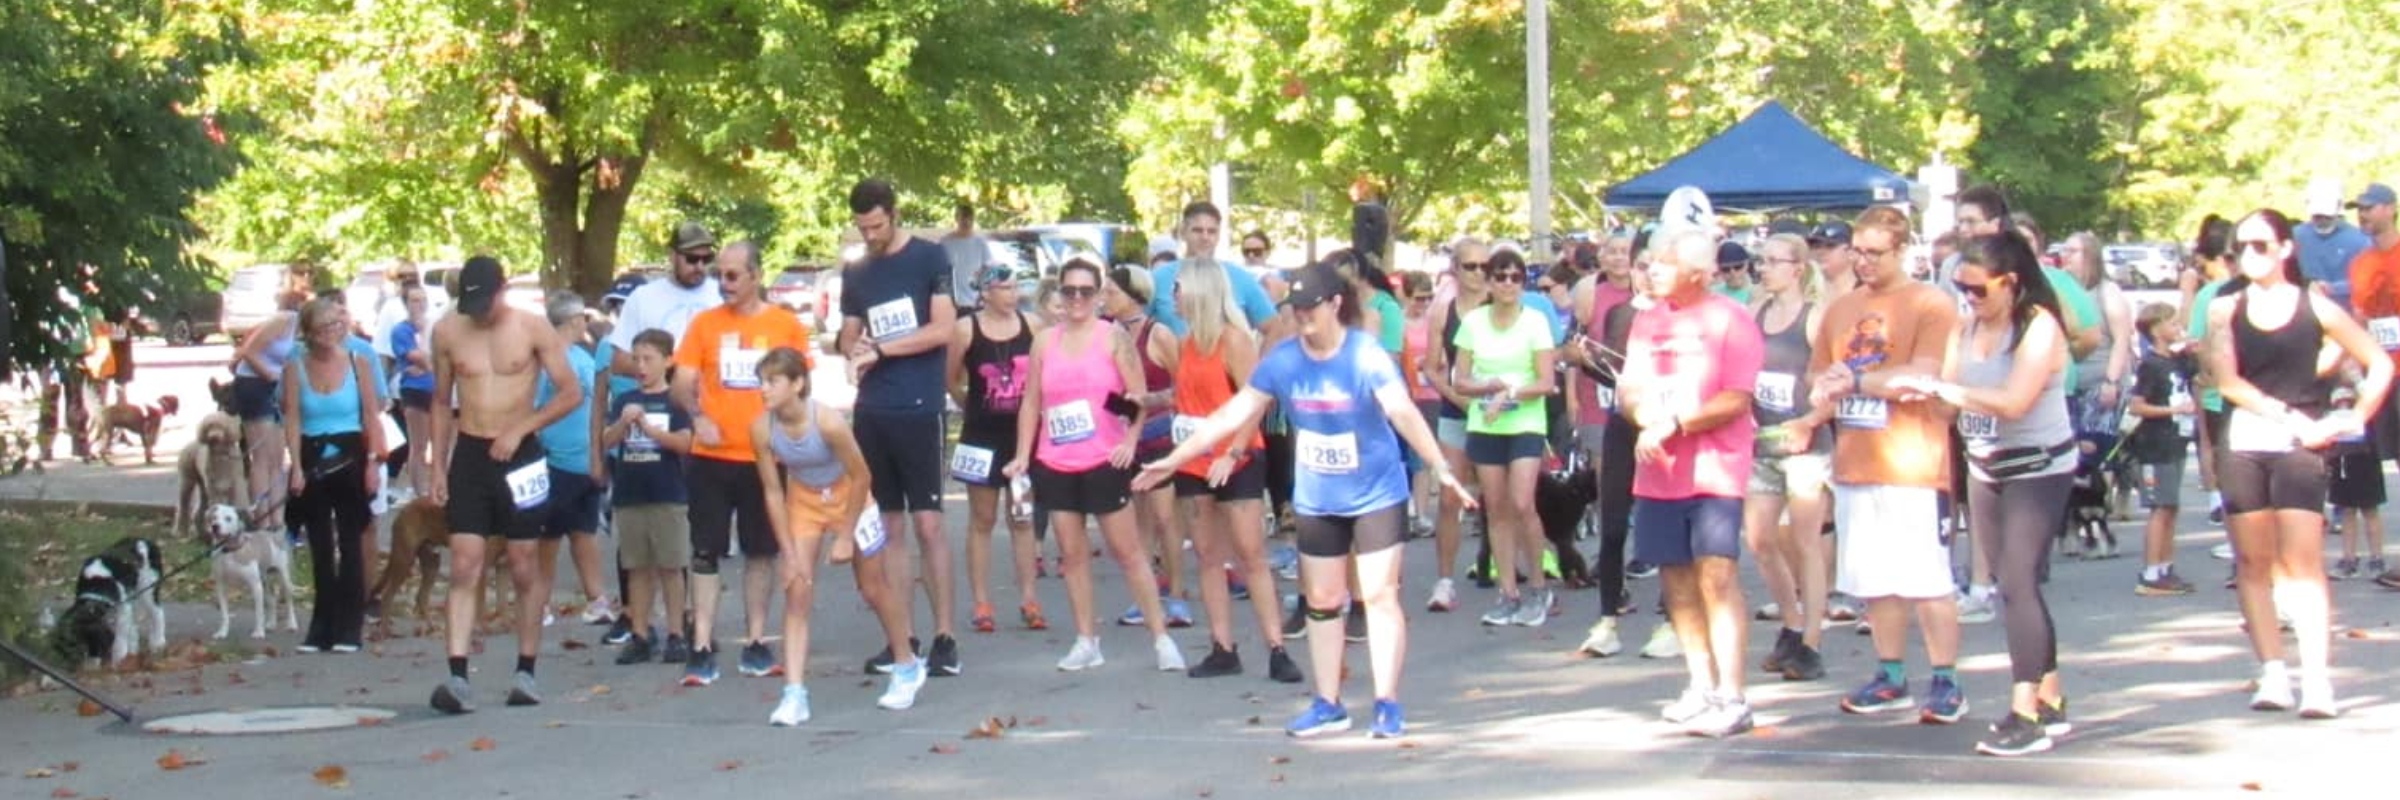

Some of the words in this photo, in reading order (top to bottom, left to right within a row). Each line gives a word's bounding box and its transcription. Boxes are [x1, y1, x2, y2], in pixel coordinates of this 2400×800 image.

[1839, 397, 1881, 415] 1272
[1050, 412, 1089, 435] 1385
[1304, 444, 1352, 466] 1285
